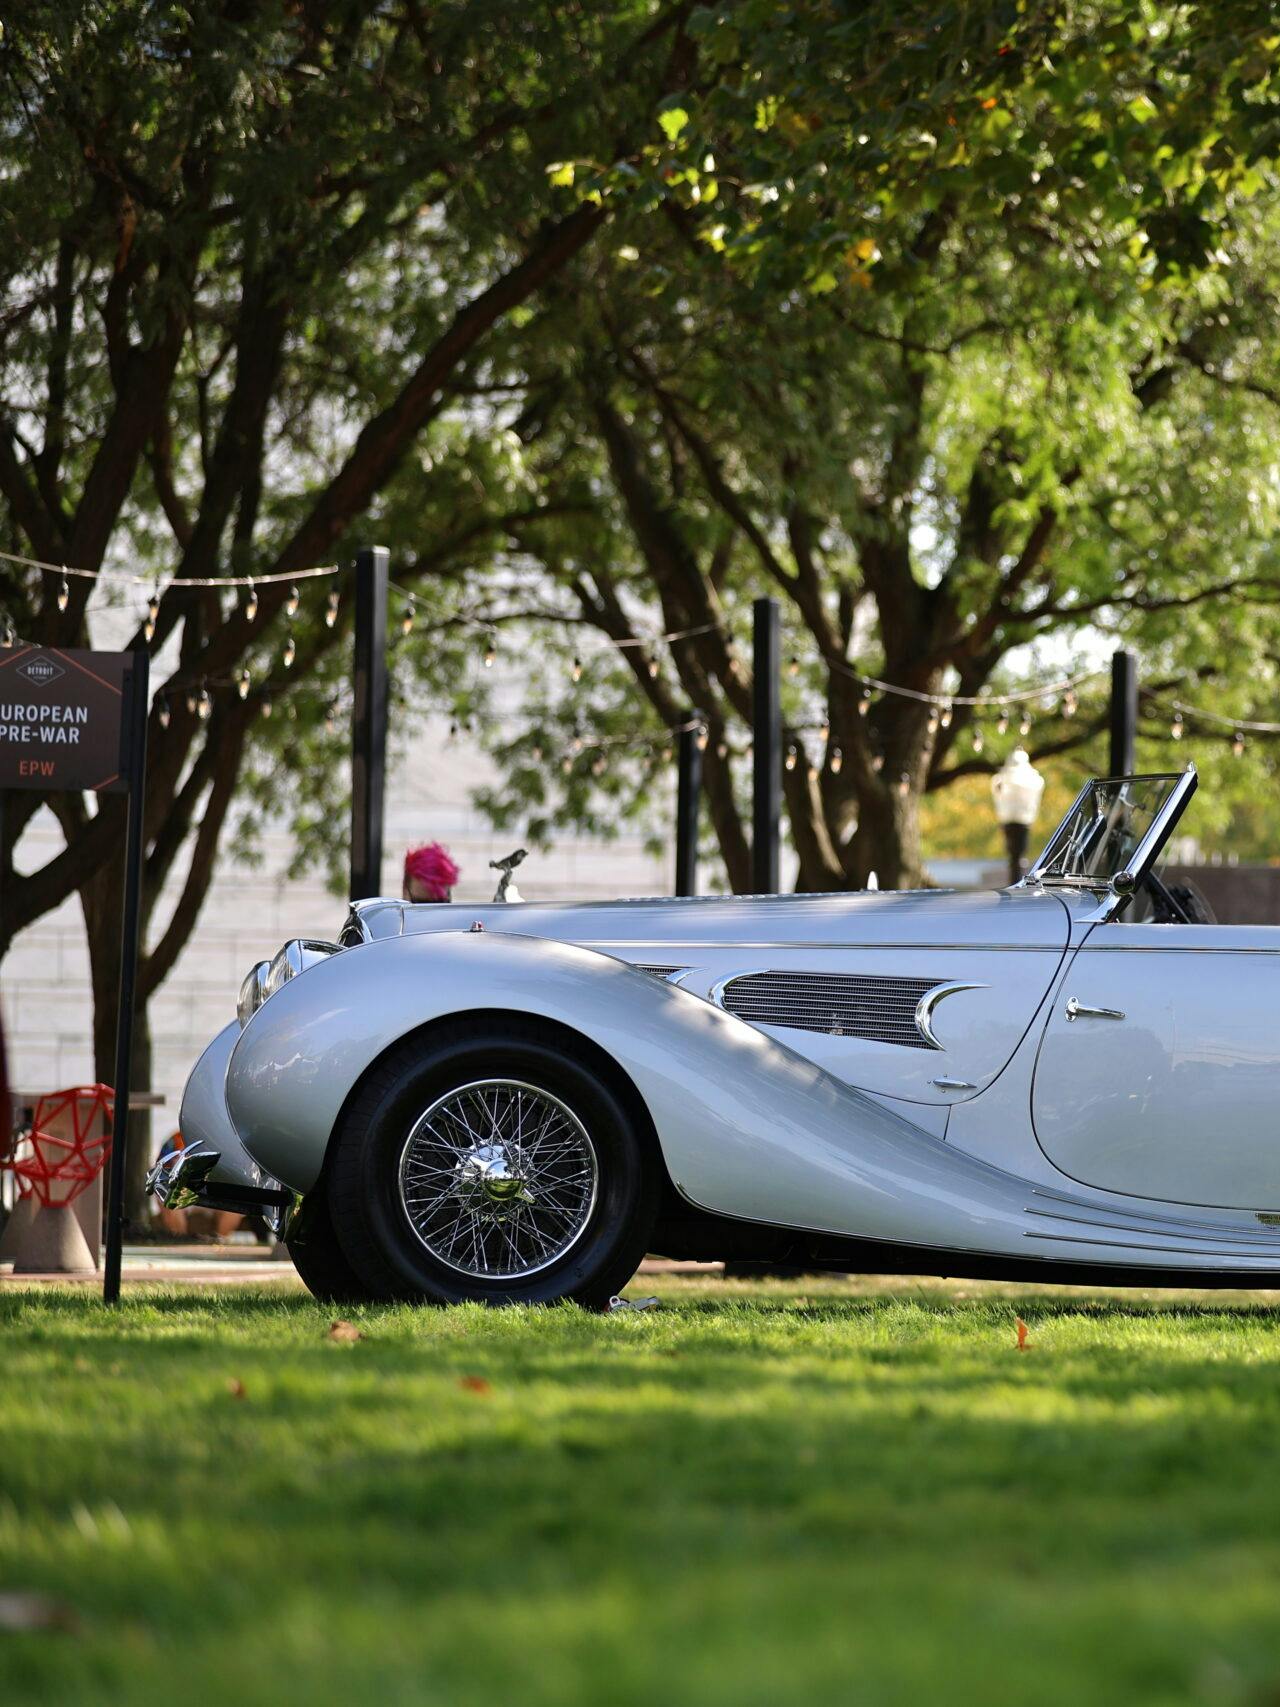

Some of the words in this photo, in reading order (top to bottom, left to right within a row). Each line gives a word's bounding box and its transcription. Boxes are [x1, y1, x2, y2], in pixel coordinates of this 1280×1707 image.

[27, 666, 54, 675] DETROIT
[0, 704, 88, 723] UROPEAN
[0, 725, 80, 744] PRE-WAR
[19, 760, 55, 776] EPW
